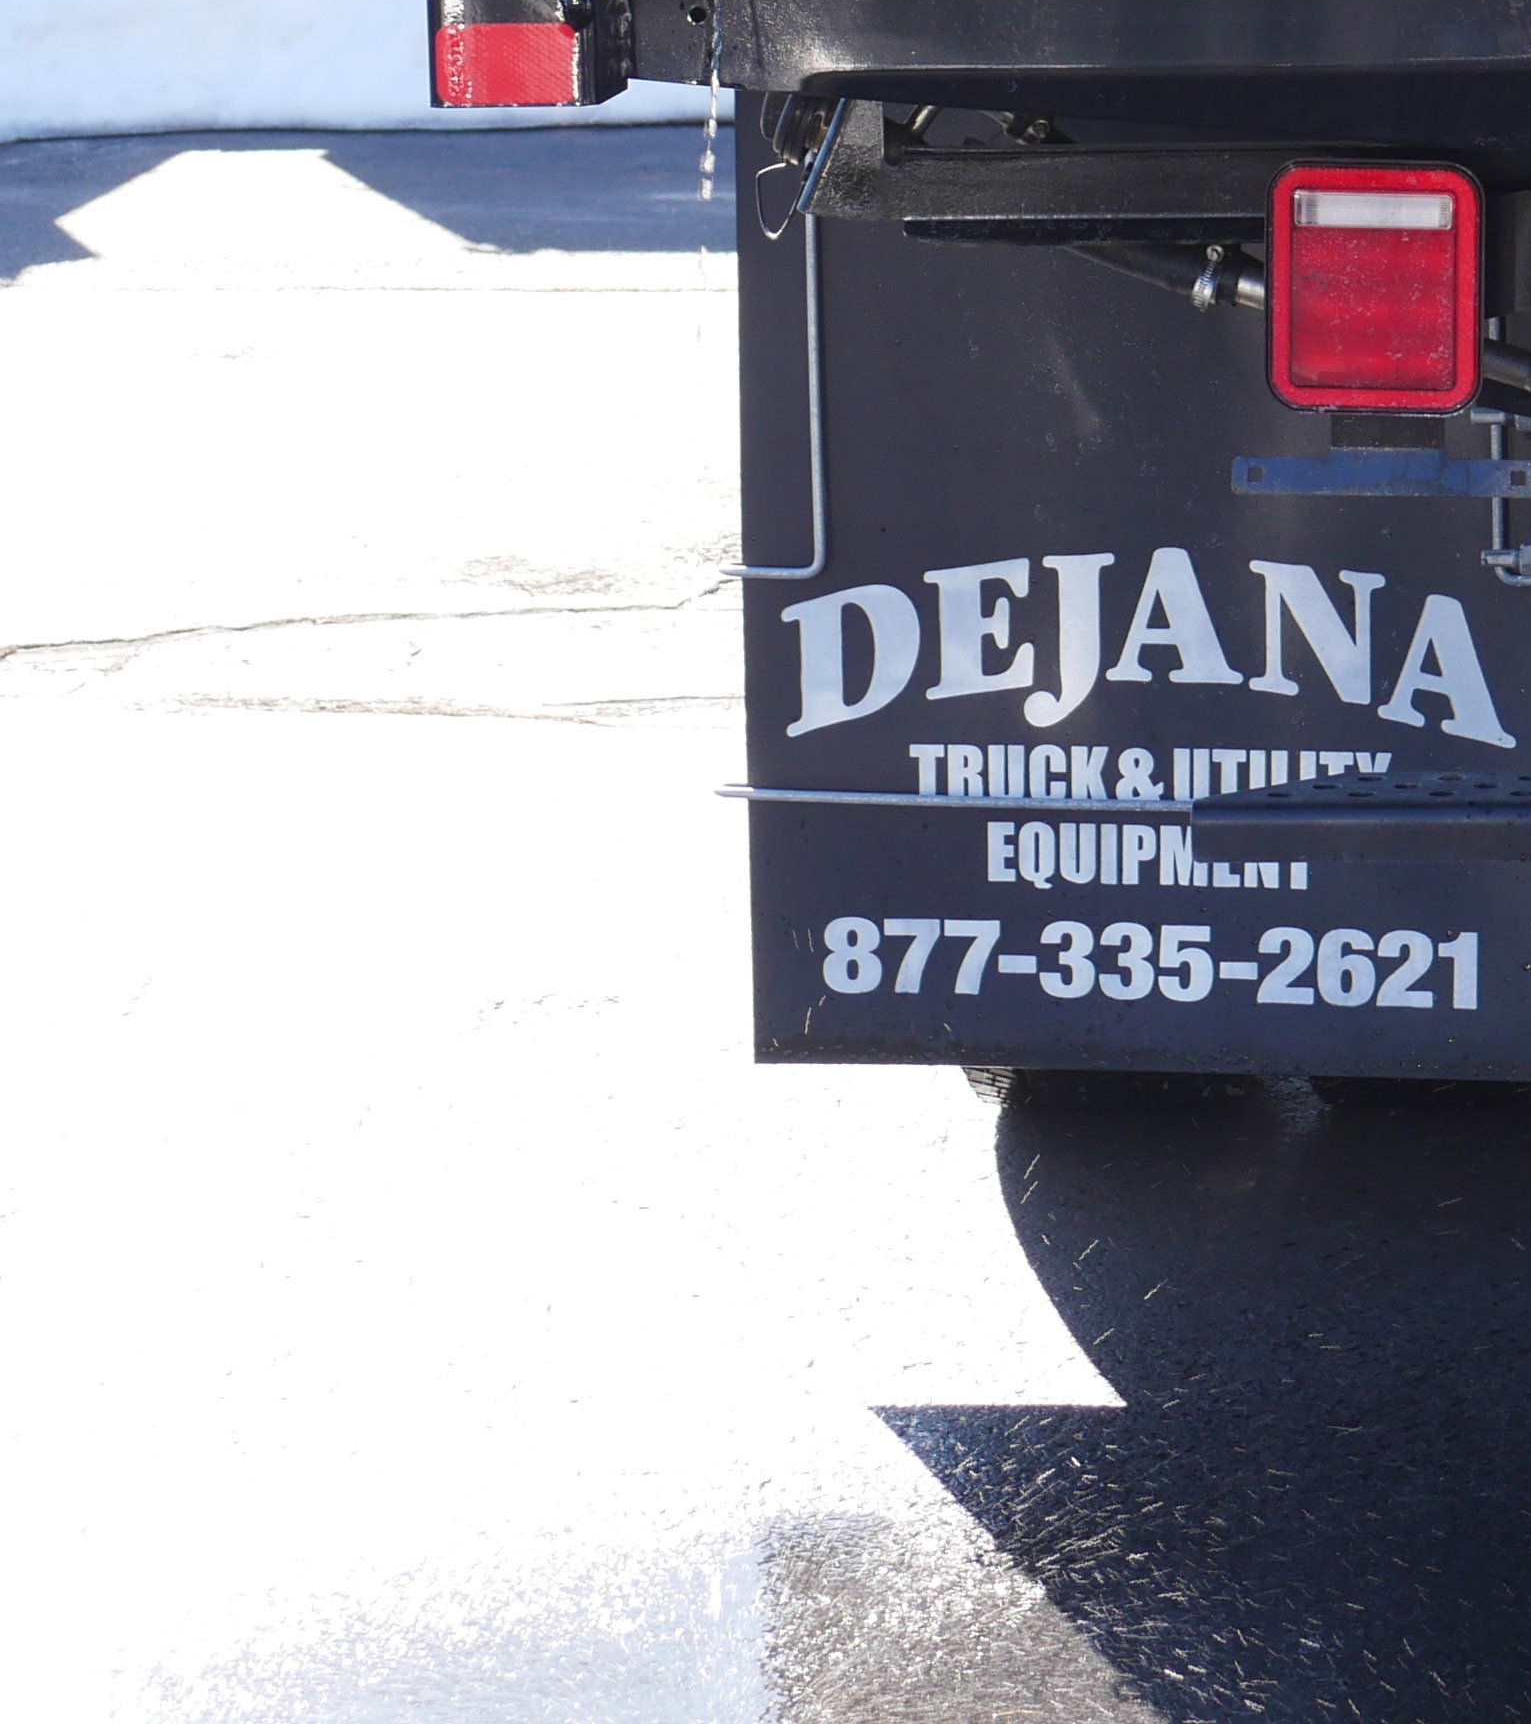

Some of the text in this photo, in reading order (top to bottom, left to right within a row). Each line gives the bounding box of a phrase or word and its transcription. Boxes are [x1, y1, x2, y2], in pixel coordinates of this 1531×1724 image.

[781, 547, 1516, 748] DEJANA
[909, 744, 1109, 800] TRUCK
[1115, 747, 1164, 801] &
[823, 916, 1480, 1010] 877-335-2621
